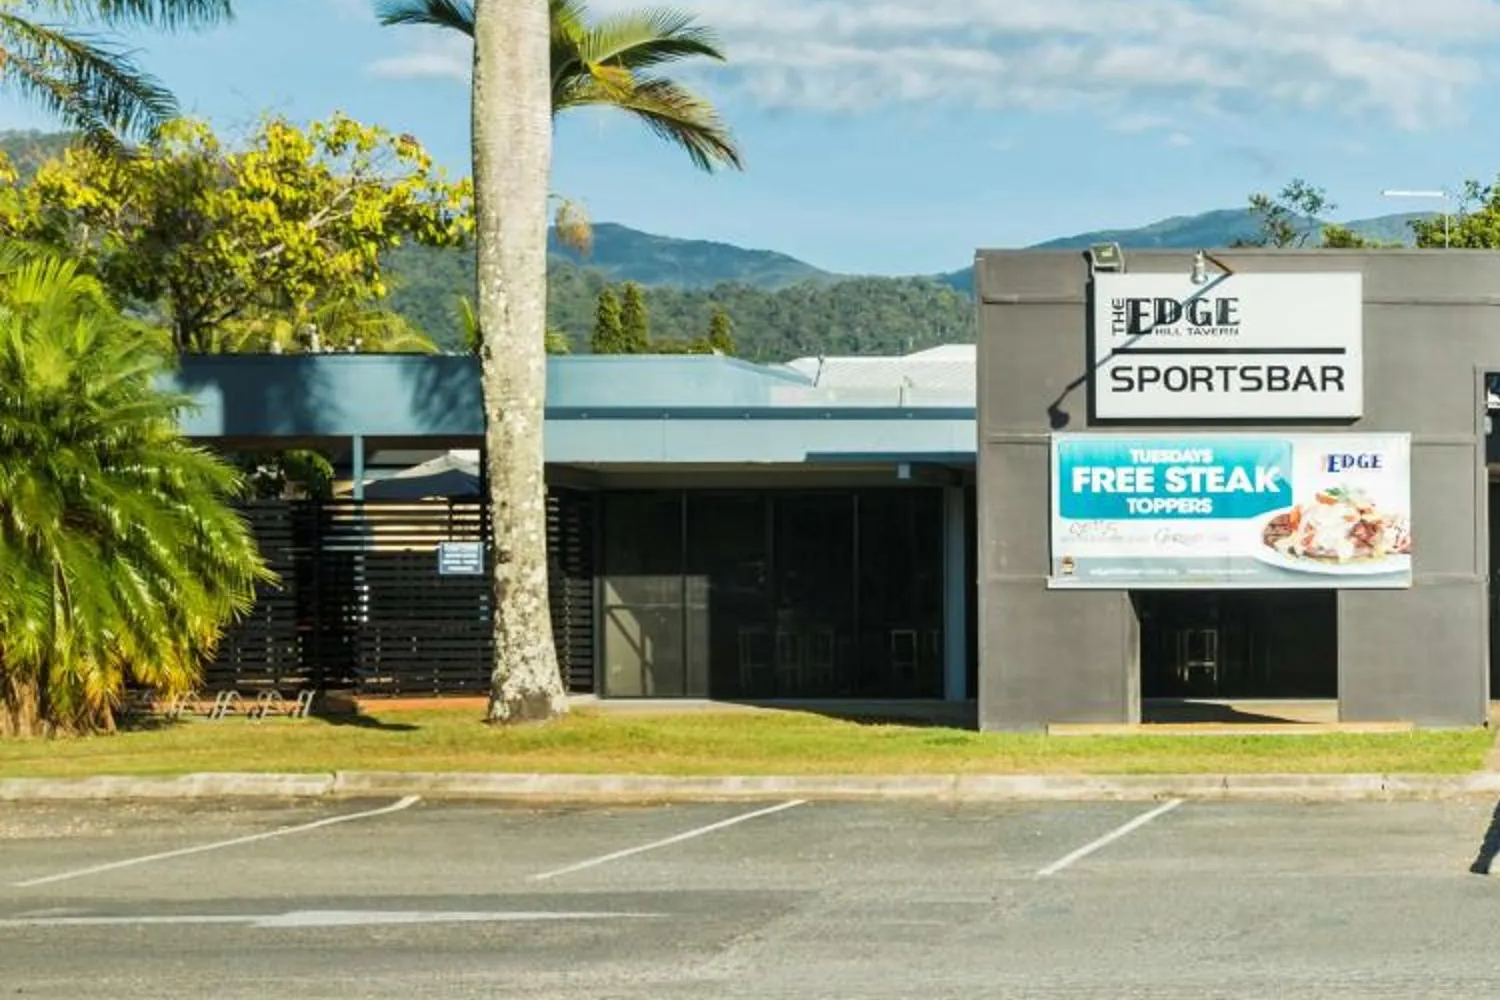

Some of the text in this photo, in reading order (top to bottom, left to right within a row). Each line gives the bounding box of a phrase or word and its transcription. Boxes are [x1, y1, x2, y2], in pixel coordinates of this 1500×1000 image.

[1111, 298, 1125, 336] THE
[1126, 298, 1240, 334] EDGE
[1155, 327, 1239, 336] HILL TAVERN
[1111, 365, 1345, 393] SPORTSBAR
[1130, 448, 1213, 463] TUESDAYS
[1327, 454, 1383, 472] EDGE
[1072, 466, 1280, 493] FREE STEAK
[1126, 497, 1213, 514] TOPPERS
